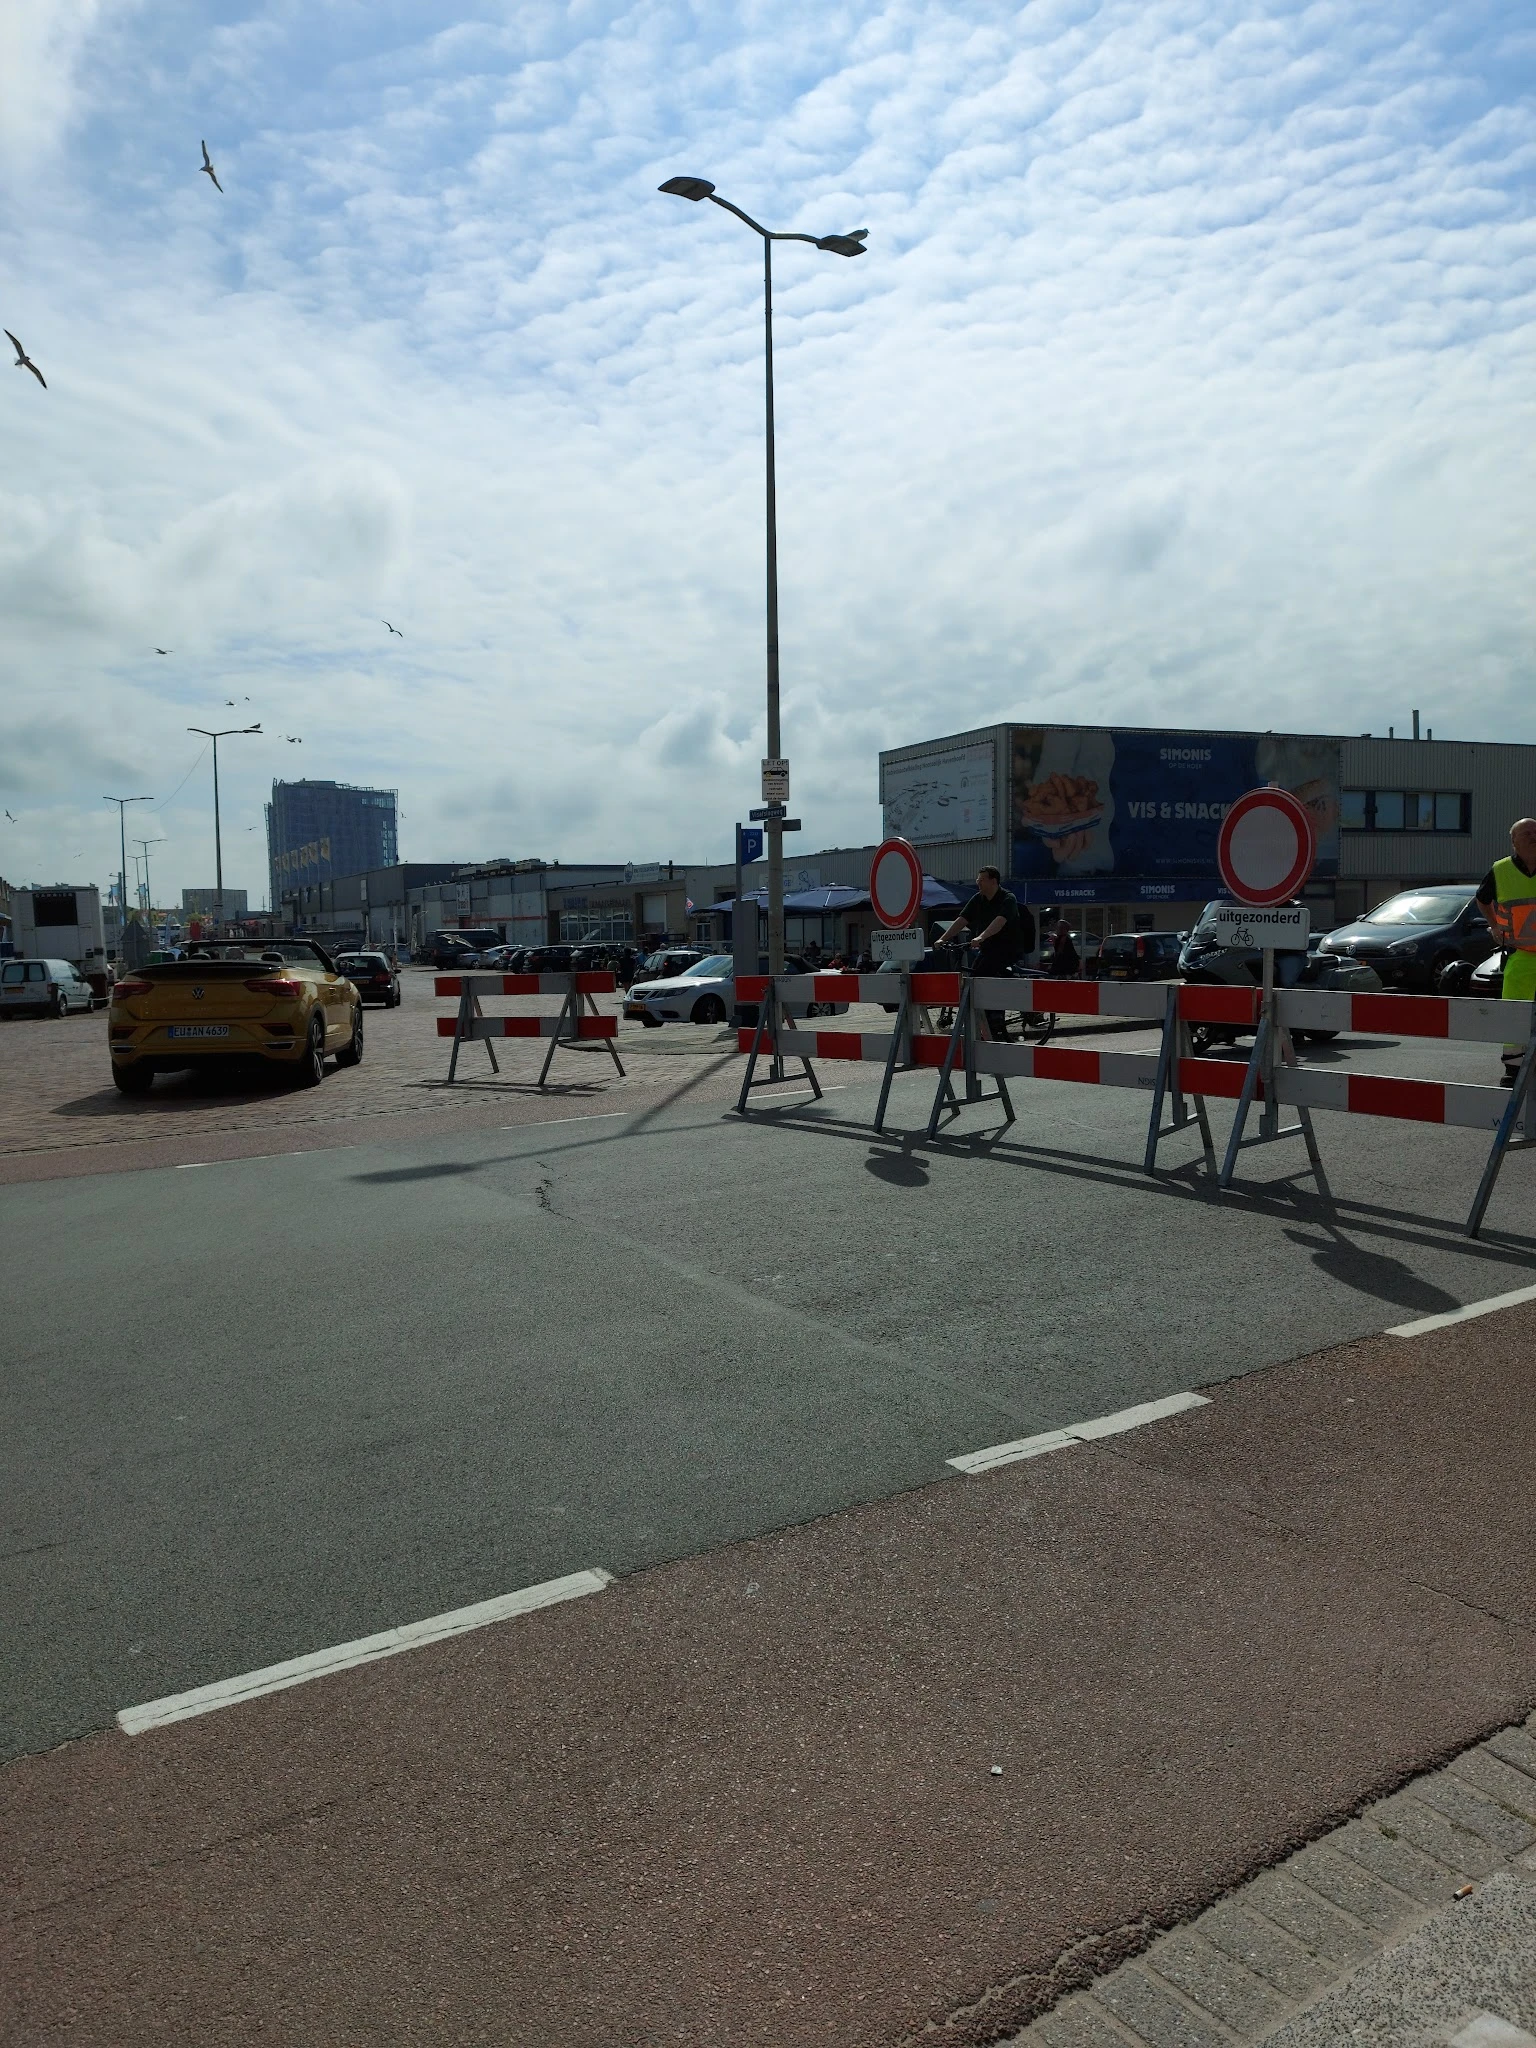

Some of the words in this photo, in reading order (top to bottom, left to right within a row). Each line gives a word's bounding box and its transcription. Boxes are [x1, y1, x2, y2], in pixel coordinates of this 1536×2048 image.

[1160, 748, 1212, 761] SIMONIS
[1128, 801, 1157, 819] VIS
[1160, 802, 1171, 819] &
[1174, 802, 1232, 820] SNACK
[748, 838, 757, 854] P
[1054, 889, 1065, 897] VIS
[1071, 889, 1096, 897] SNACKS
[1140, 885, 1176, 895] SIMONIS
[1217, 887, 1227, 895] VIS
[1219, 910, 1301, 925] uitgezonderd
[872, 930, 917, 944] uitgezonderd
[174, 1027, 186, 1037] EU
[192, 1027, 204, 1036] AN
[205, 1026, 228, 1036] 4639
